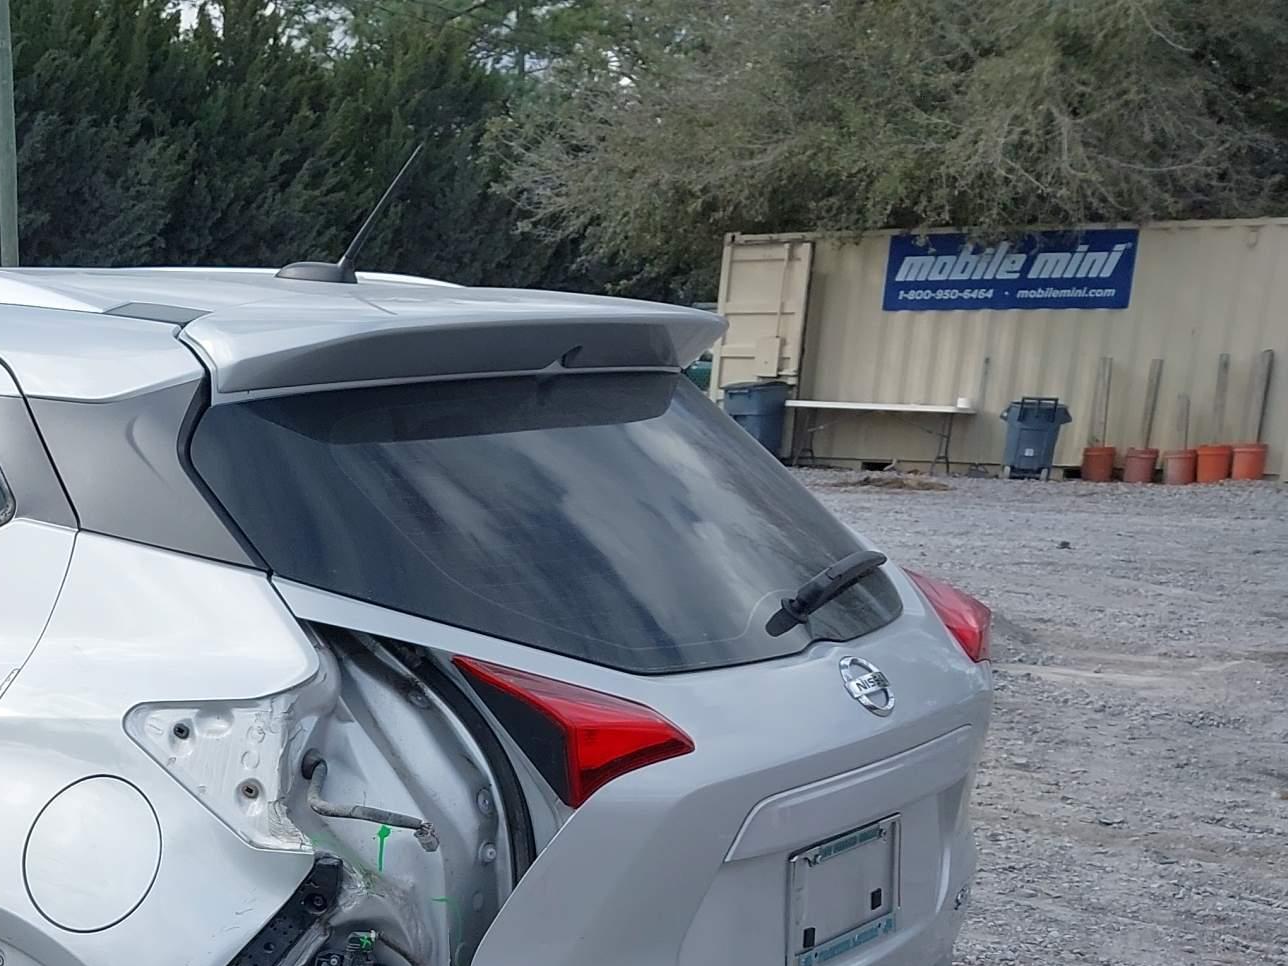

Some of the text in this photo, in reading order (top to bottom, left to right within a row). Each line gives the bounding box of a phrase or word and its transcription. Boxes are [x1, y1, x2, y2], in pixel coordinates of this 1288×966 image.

[895, 241, 1127, 281] mobile mini
[1016, 286, 1116, 298] mobilemini.com
